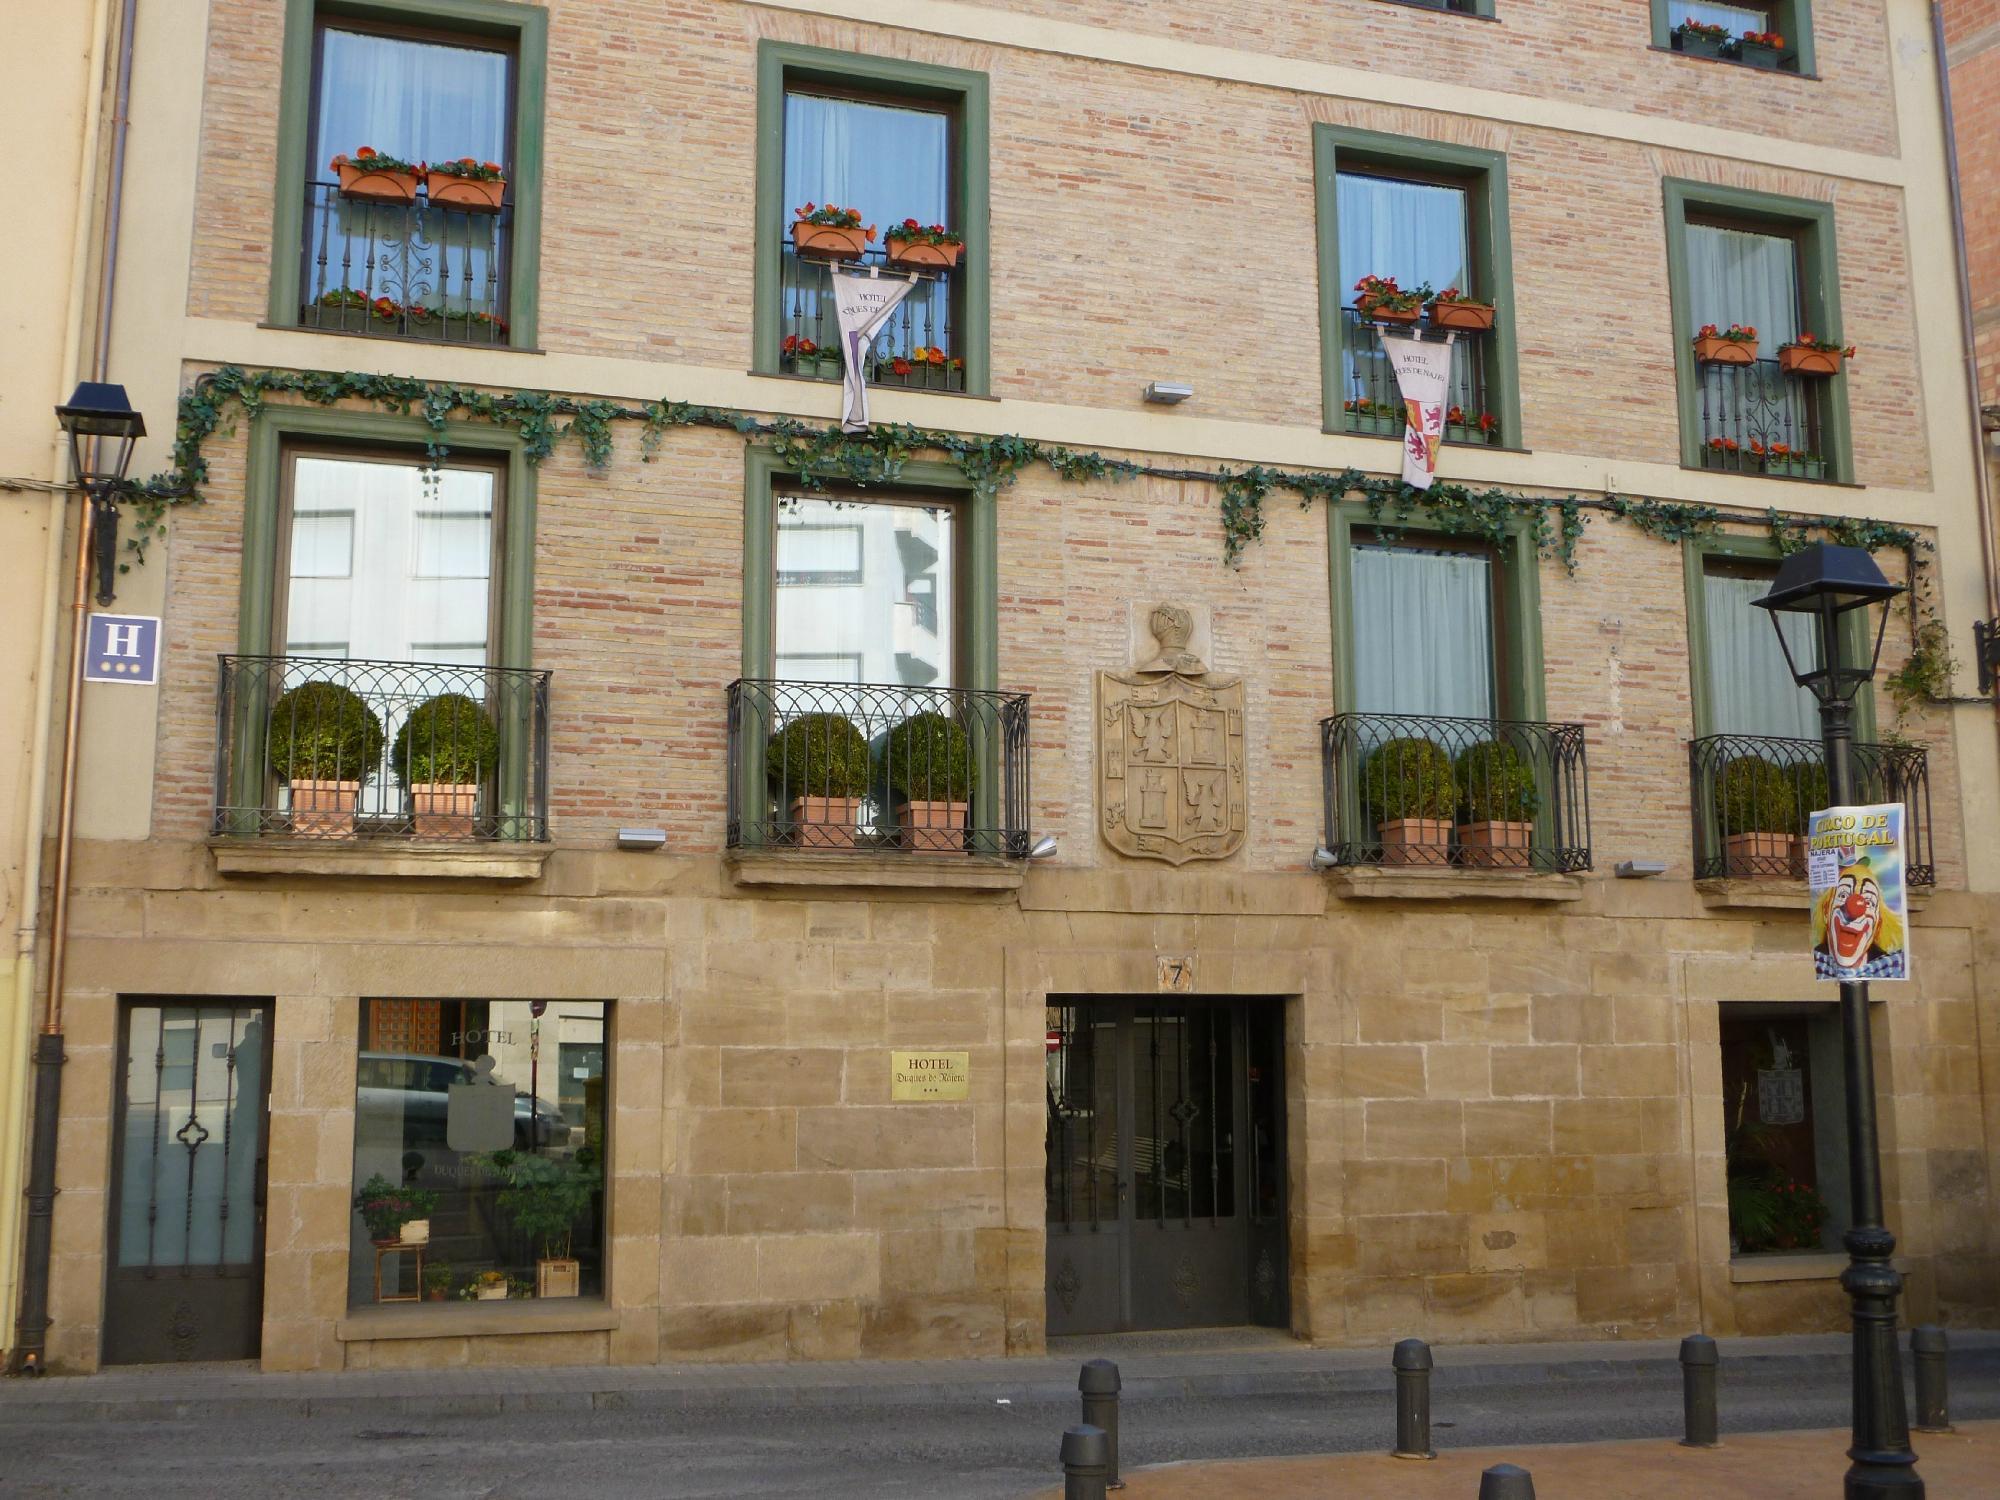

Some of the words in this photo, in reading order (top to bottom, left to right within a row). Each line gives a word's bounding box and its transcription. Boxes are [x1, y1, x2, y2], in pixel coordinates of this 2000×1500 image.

[859, 293, 886, 303] HOTEL
[1403, 354, 1429, 365] HOTEL
[102, 623, 143, 658] H
[1816, 814, 1856, 833] CIRCO
[1861, 812, 1889, 830] DE
[1810, 830, 1895, 850] PORTUGAL
[1170, 965, 1182, 984] 7
[449, 1029, 518, 1047] HOTEL
[908, 1058, 954, 1070] HOTEL
[896, 1072, 927, 1084] Duques
[928, 1072, 937, 1082] de
